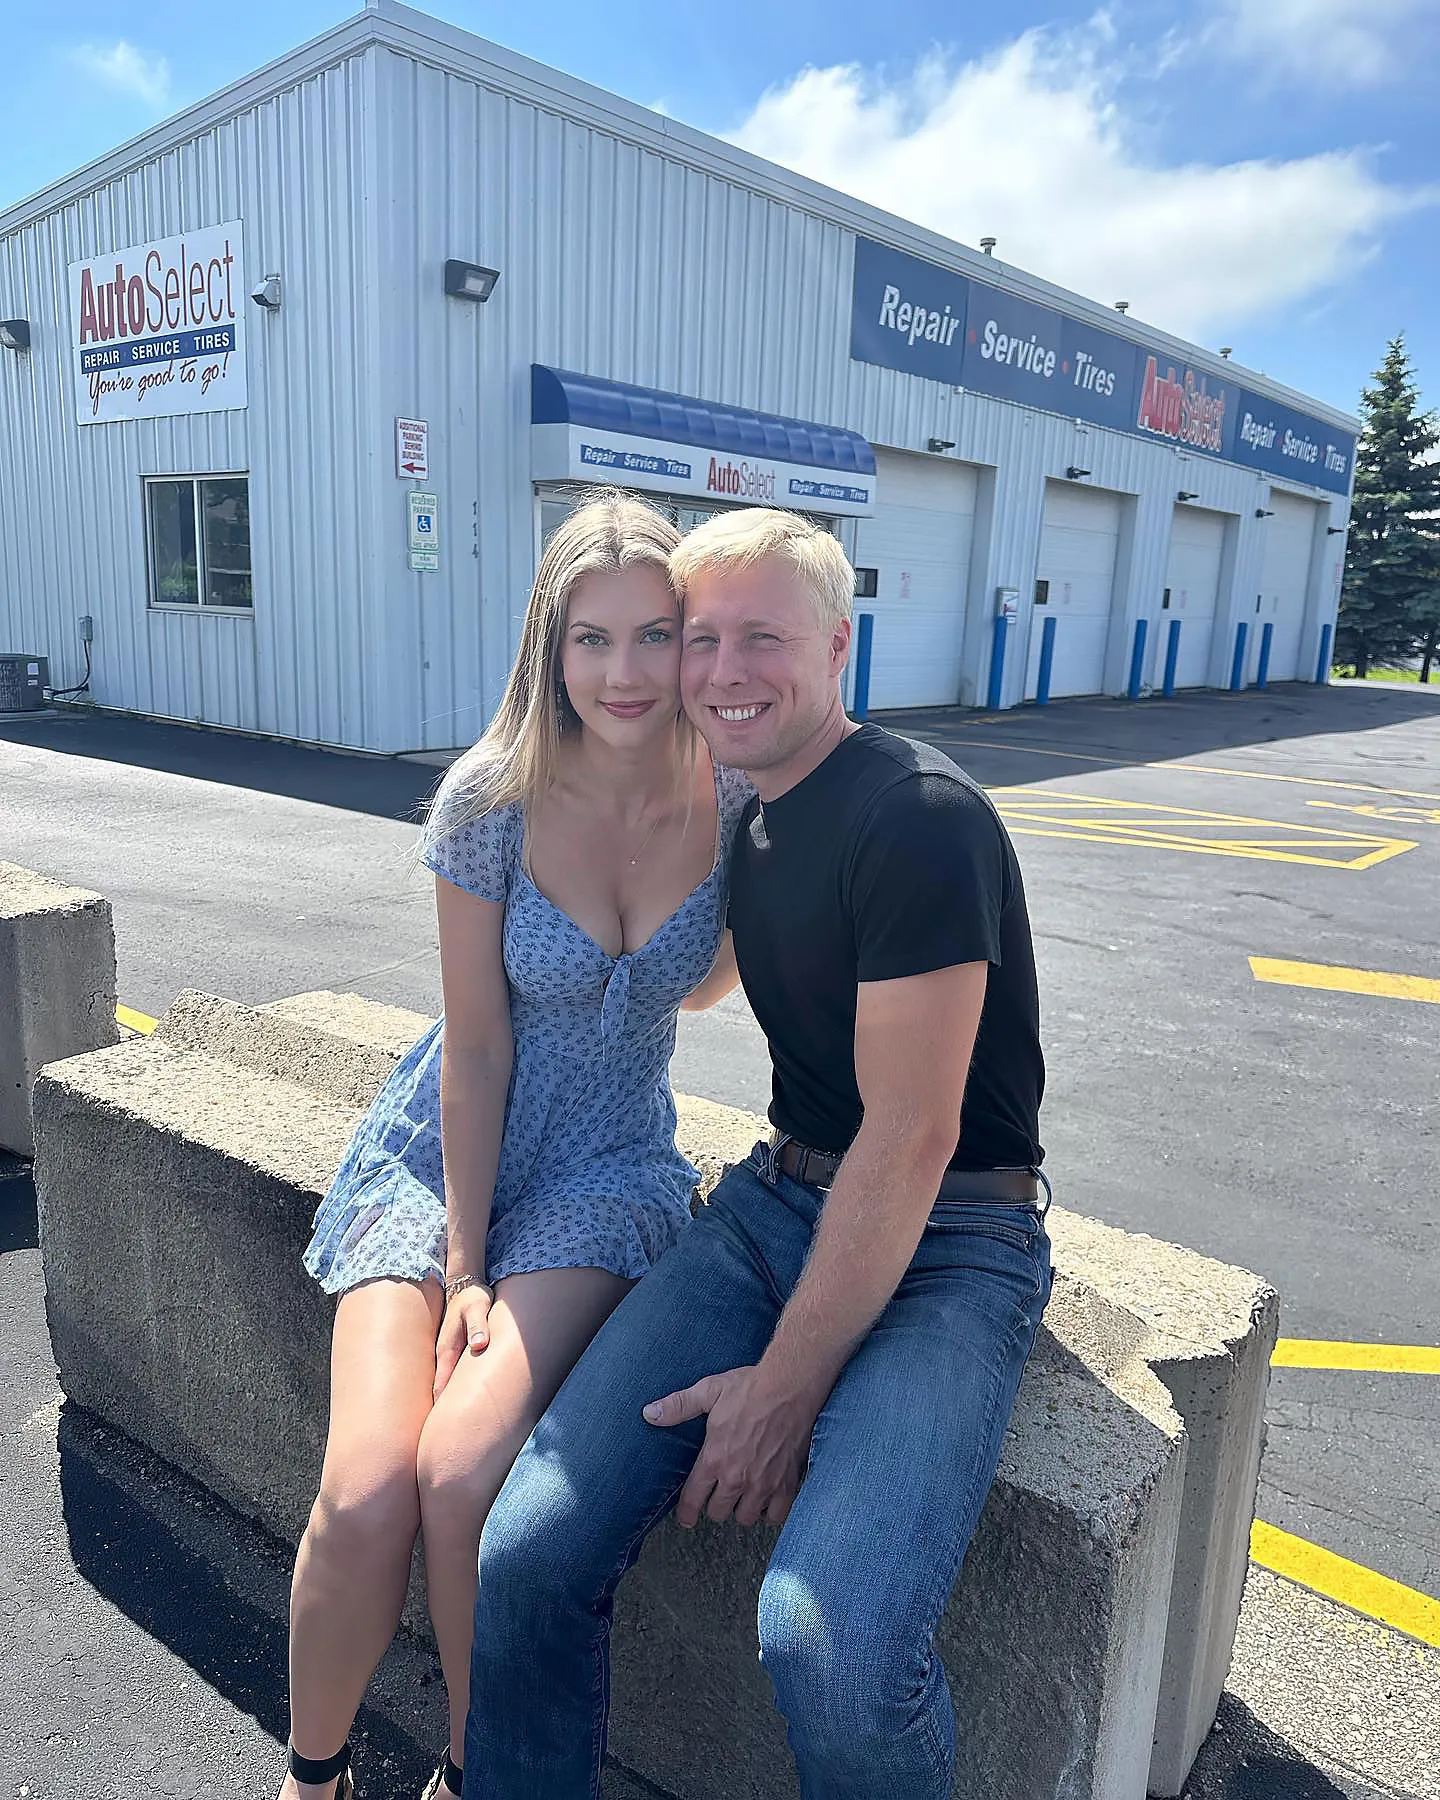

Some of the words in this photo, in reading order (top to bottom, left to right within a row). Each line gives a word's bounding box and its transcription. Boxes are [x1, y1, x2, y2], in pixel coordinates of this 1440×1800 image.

[80, 240, 235, 345] AutoSelect
[84, 350, 120, 369] REPAIR
[132, 340, 180, 360] SERVICE
[194, 332, 230, 351] TIRES
[878, 284, 960, 346] Repair
[980, 320, 1056, 378] Service
[1073, 351, 1115, 396] Tires
[87, 370, 134, 416] You're
[138, 360, 175, 402] good
[179, 359, 198, 384] to
[201, 352, 229, 395] go!
[402, 431, 423, 442] PARKING
[404, 441, 422, 451] BEHIND
[1240, 412, 1277, 451] Repair
[1281, 429, 1319, 464] Service
[1324, 444, 1347, 474] Tires
[402, 450, 424, 461] BUILDING
[584, 447, 616, 465] Repair
[623, 454, 658, 471] Service
[666, 461, 689, 475] Tires
[707, 456, 776, 499] AutoSelect
[791, 480, 814, 494] Repair
[819, 485, 845, 498] Service
[850, 489, 867, 500] Tires
